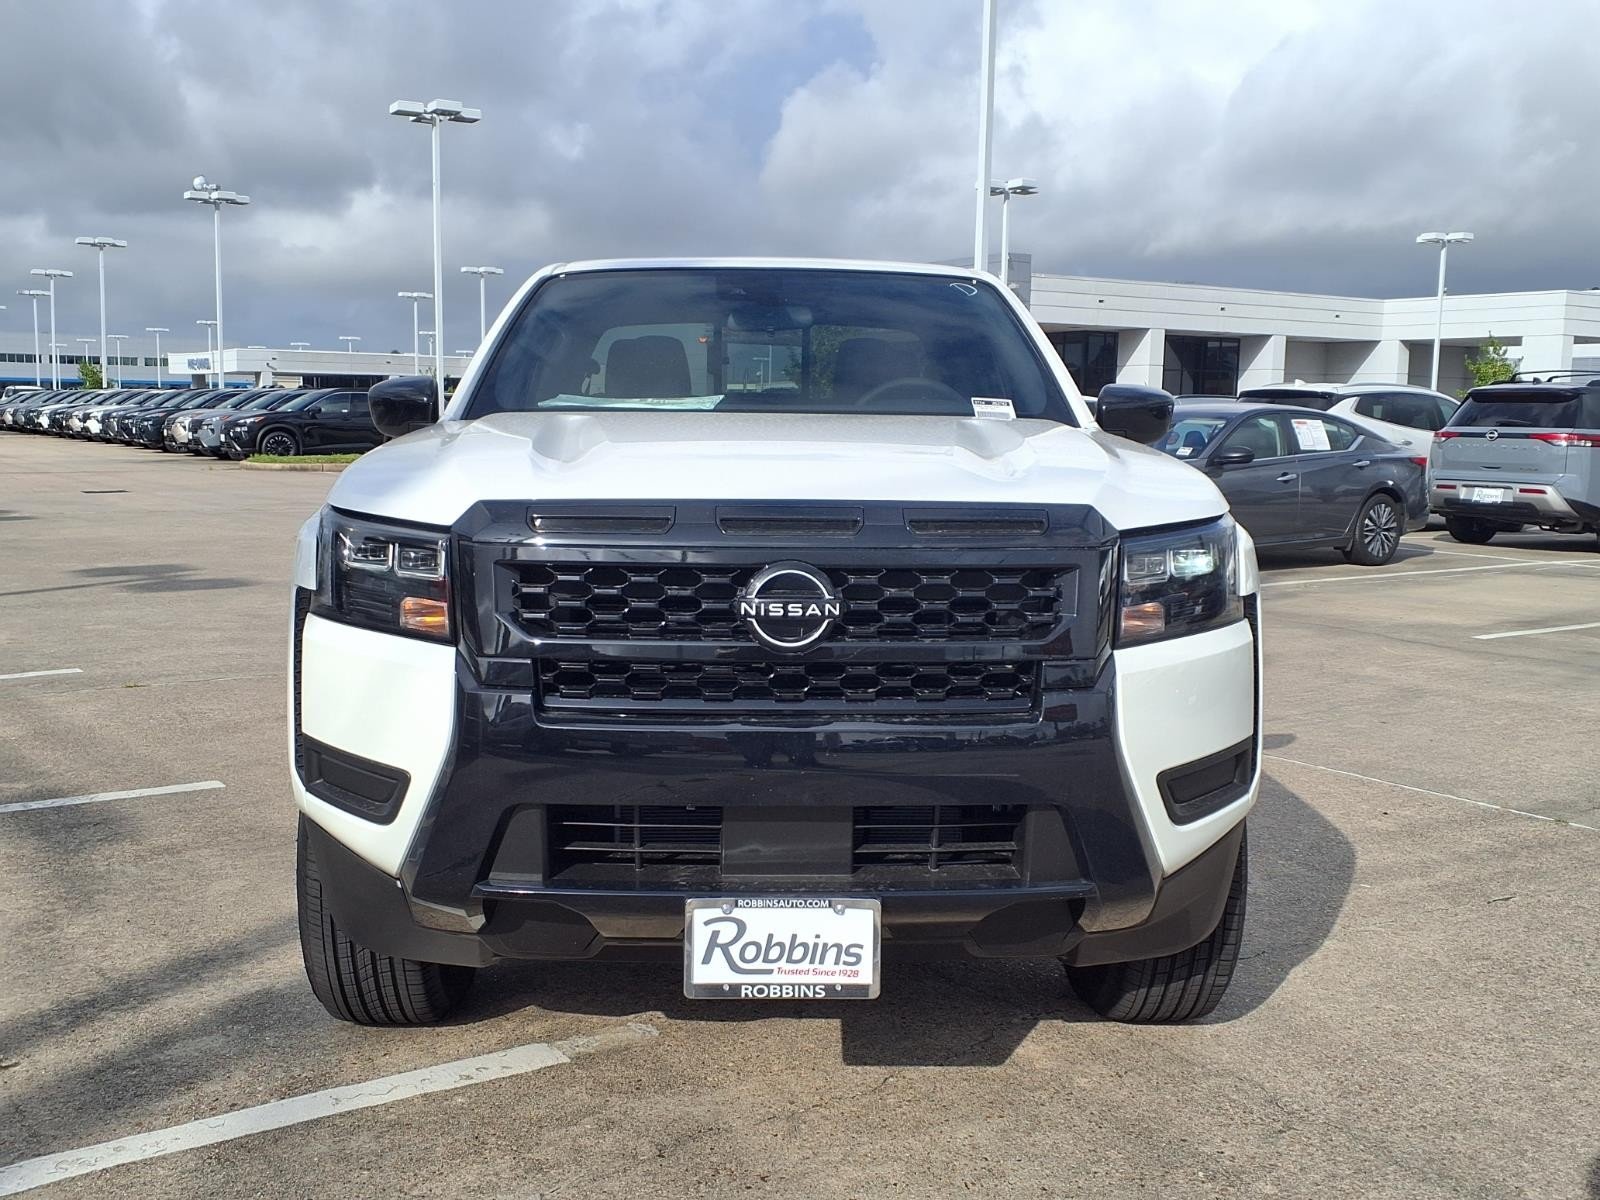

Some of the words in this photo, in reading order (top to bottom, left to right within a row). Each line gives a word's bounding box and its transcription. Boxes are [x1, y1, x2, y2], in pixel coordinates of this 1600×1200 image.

[740, 602, 840, 616] NISSAN
[737, 899, 829, 909] ROBBINSAUTO.COM
[701, 916, 864, 975] Robbins
[776, 967, 810, 976] Trusted
[812, 968, 837, 977] Since
[838, 969, 860, 978] 1928
[741, 984, 826, 998] ROBBINS
